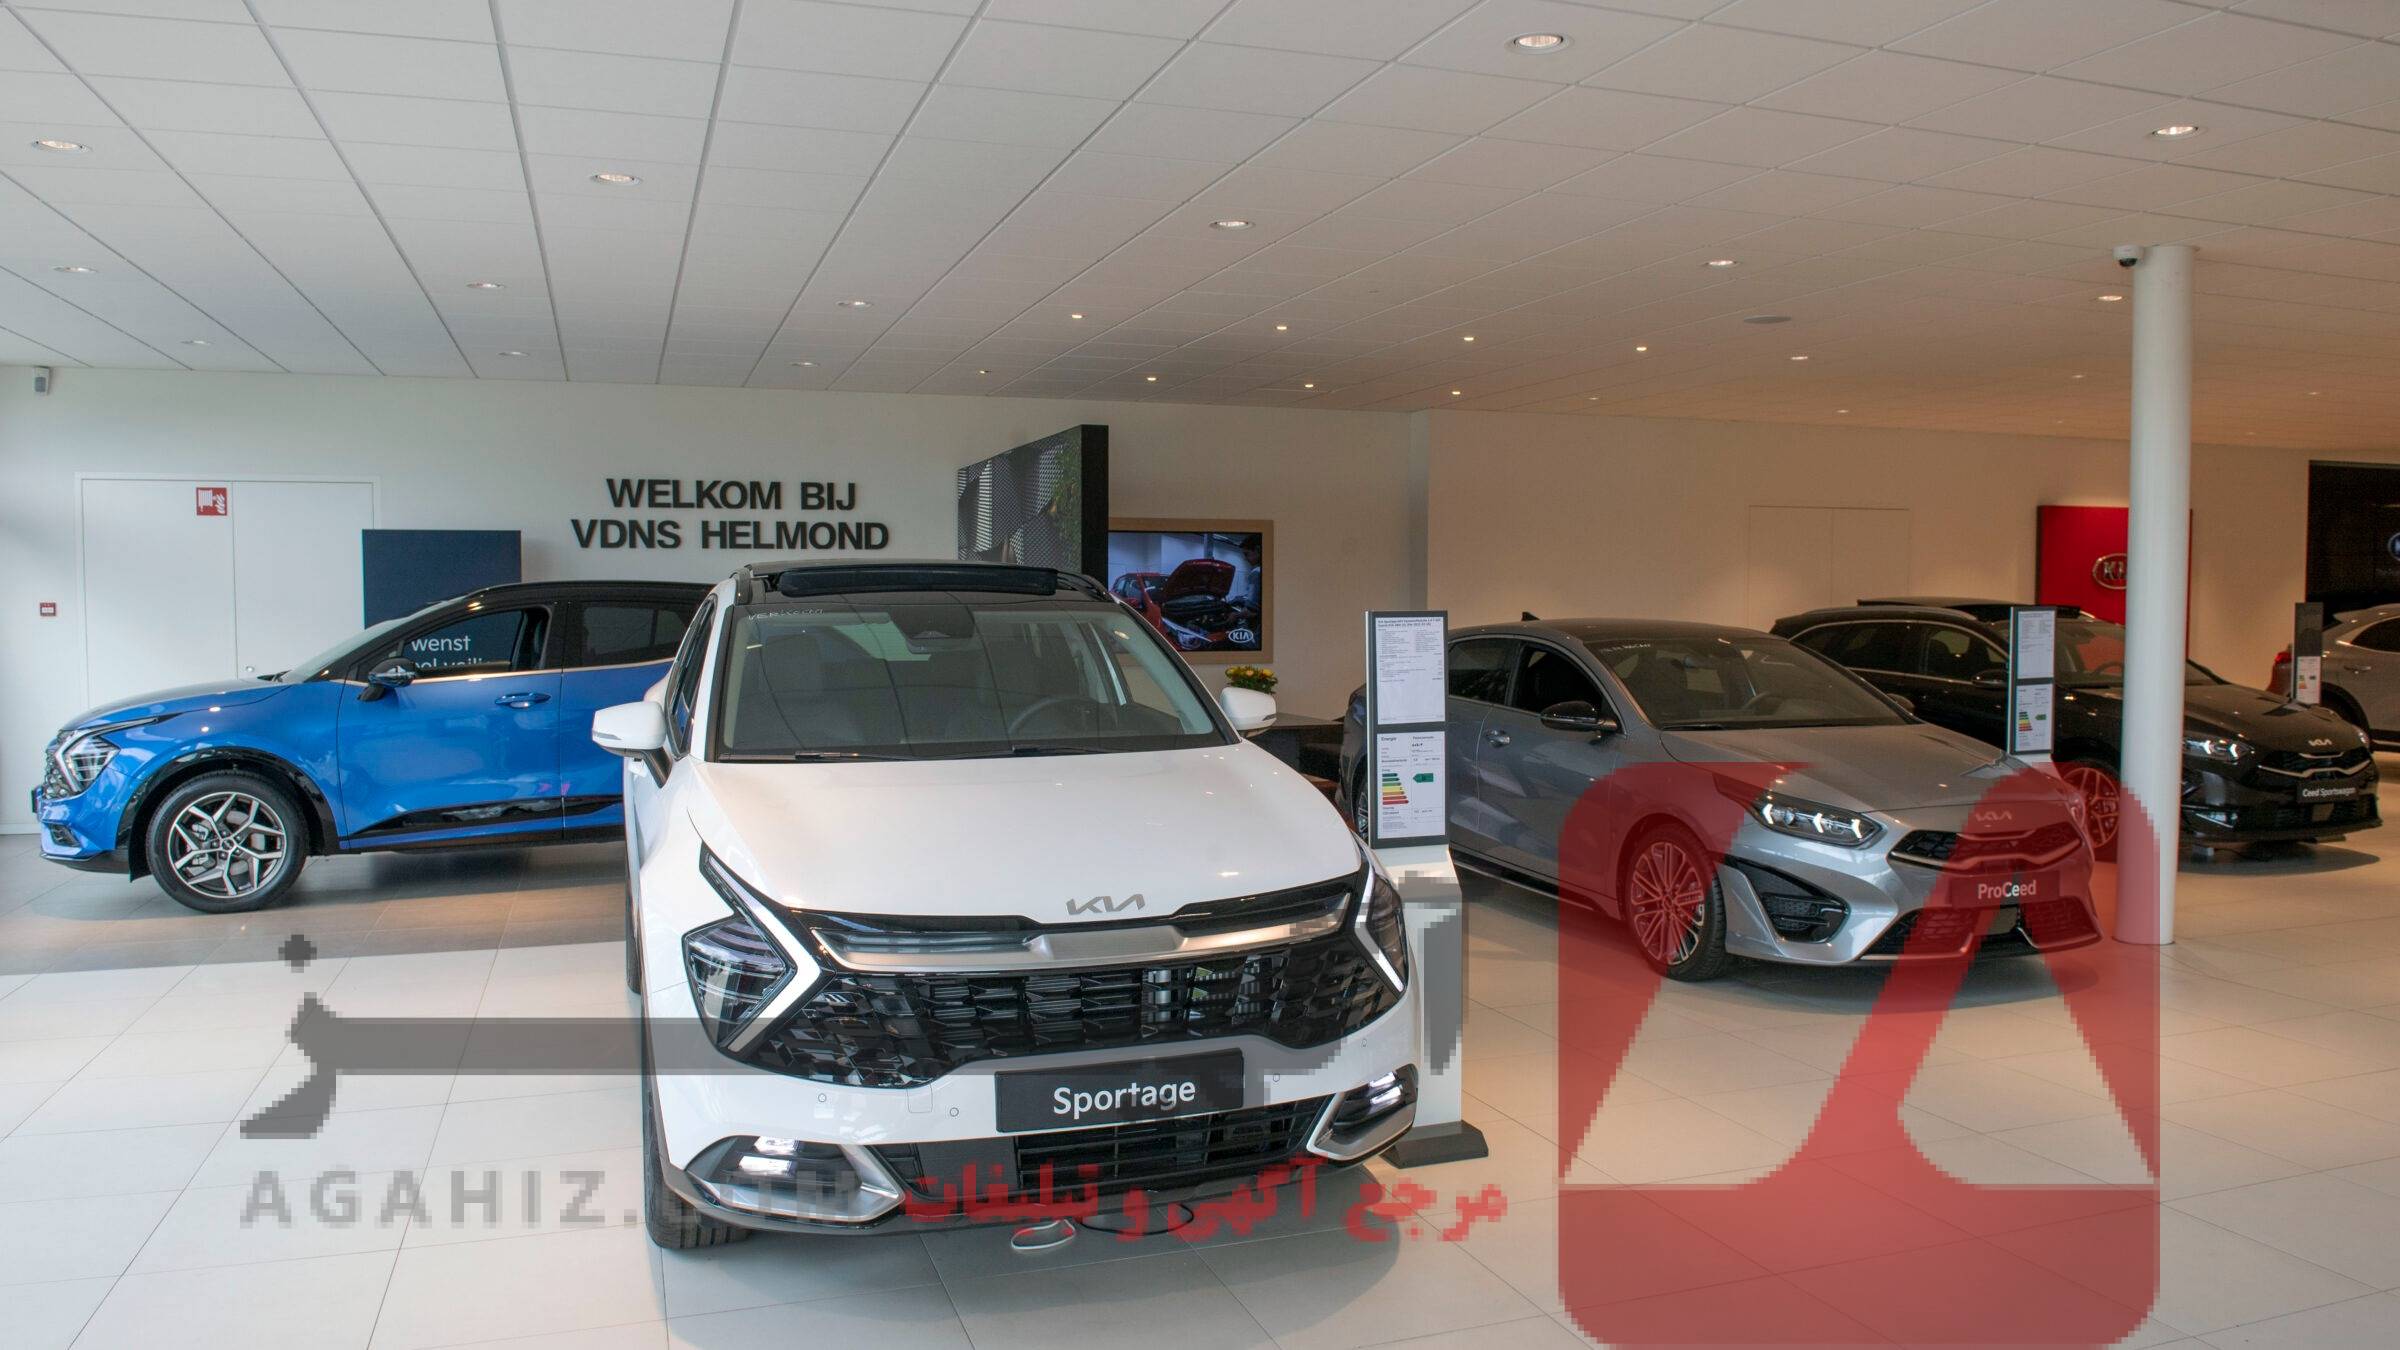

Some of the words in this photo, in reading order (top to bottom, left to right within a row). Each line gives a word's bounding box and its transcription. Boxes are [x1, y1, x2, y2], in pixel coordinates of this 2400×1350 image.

[606, 478, 781, 510] WELKOM
[800, 482, 856, 511] BIJ
[571, 519, 682, 549] VDNS
[701, 520, 890, 550] HELMOND
[411, 635, 471, 651] wenst
[1977, 880, 2037, 899] ProCeed
[1053, 1082, 1195, 1119] Sportage
